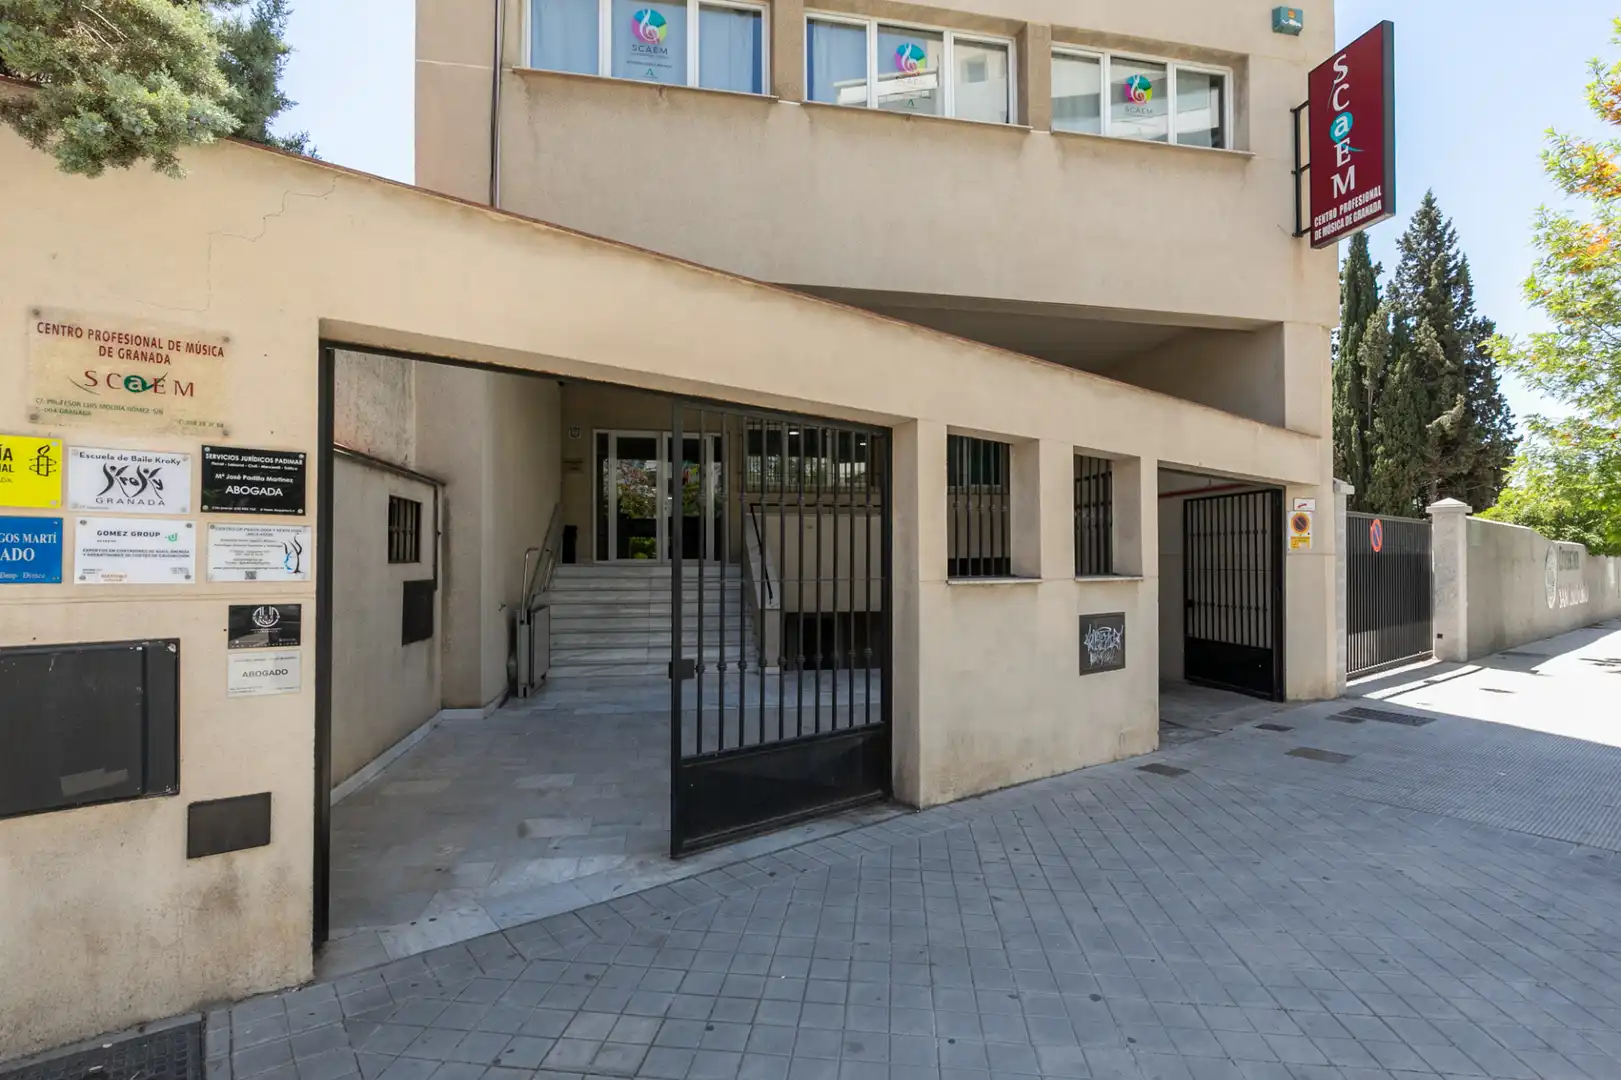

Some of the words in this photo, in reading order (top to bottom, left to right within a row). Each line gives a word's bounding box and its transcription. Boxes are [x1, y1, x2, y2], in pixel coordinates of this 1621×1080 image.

[632, 44, 668, 55] SCAEM
[1314, 208, 1337, 227] CENTRO
[1339, 185, 1382, 215] PROFESIONAL
[1314, 229, 1322, 241] DE
[1322, 218, 1344, 237] MÚSICA
[1345, 214, 1353, 227] DE
[1353, 200, 1382, 222] GRANADA
[37, 322, 83, 339] CENTRO
[88, 328, 163, 350] PROFESIONAL
[168, 340, 180, 352] DE
[185, 341, 224, 358] MÚSICA
[99, 345, 113, 358] DE
[118, 348, 171, 365] GRANADA
[80, 451, 115, 461] Escuela
[116, 453, 129, 461] de
[130, 455, 153, 463] Baile
[205, 453, 239, 462] SERVICIOS
[240, 454, 273, 464] JURÍDICOS
[274, 458, 303, 466] PADIMAR
[225, 485, 284, 497] ABOGADA
[95, 498, 166, 506] GRANADA
[22, 531, 57, 544] MARTÍ
[97, 530, 128, 538] GOMEZ
[131, 531, 161, 539] GROUP
[241, 668, 289, 678] ABOGADO
